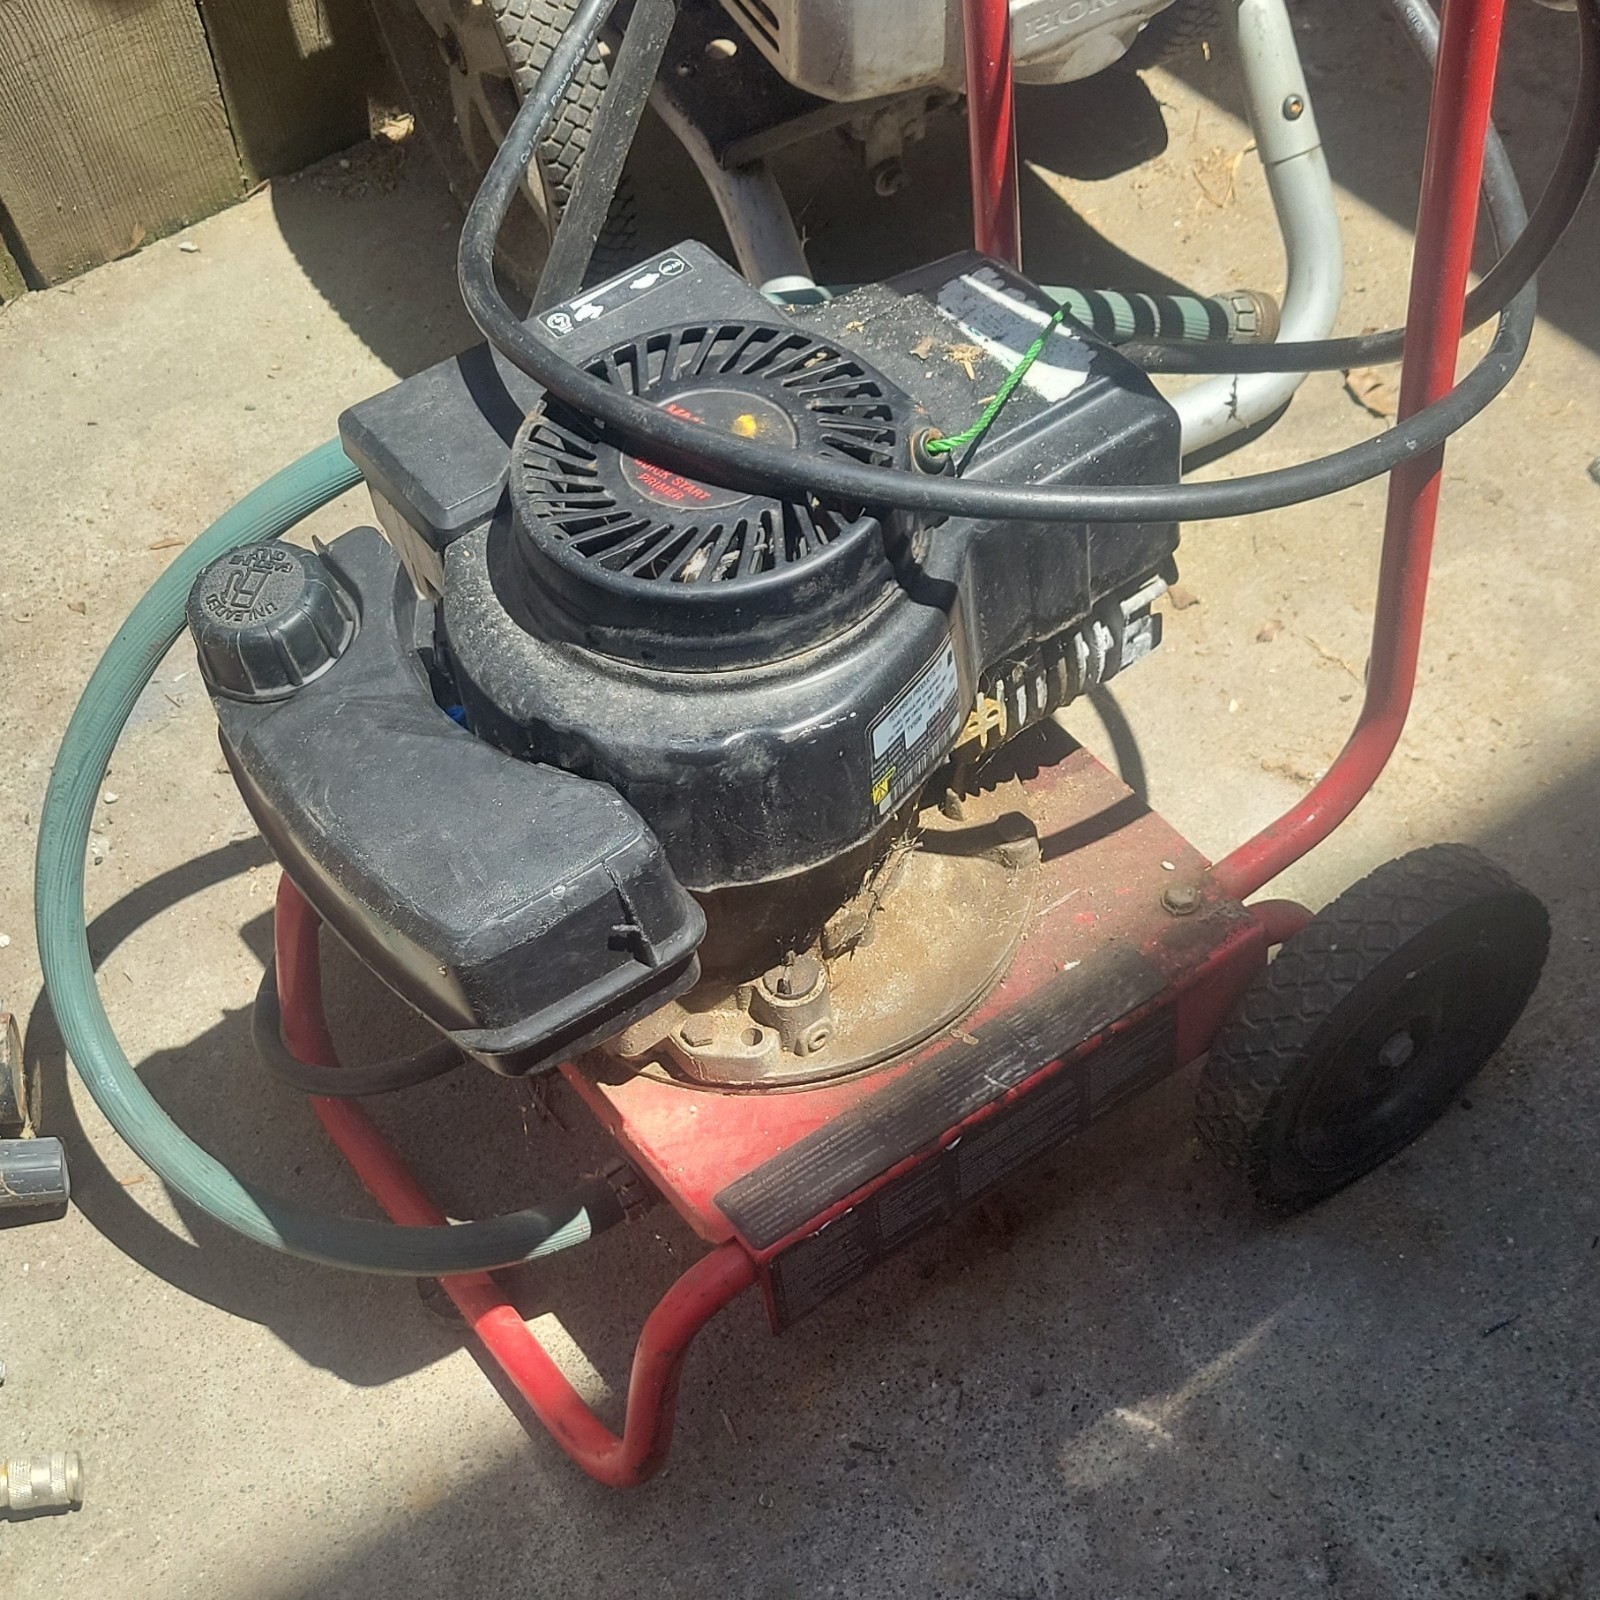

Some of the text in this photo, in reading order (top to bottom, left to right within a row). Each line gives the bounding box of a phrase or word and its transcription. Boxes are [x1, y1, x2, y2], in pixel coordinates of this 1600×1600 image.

[637, 472, 685, 501] PRIMER
[671, 476, 712, 501] START
[205, 593, 279, 622] UNLEADED
